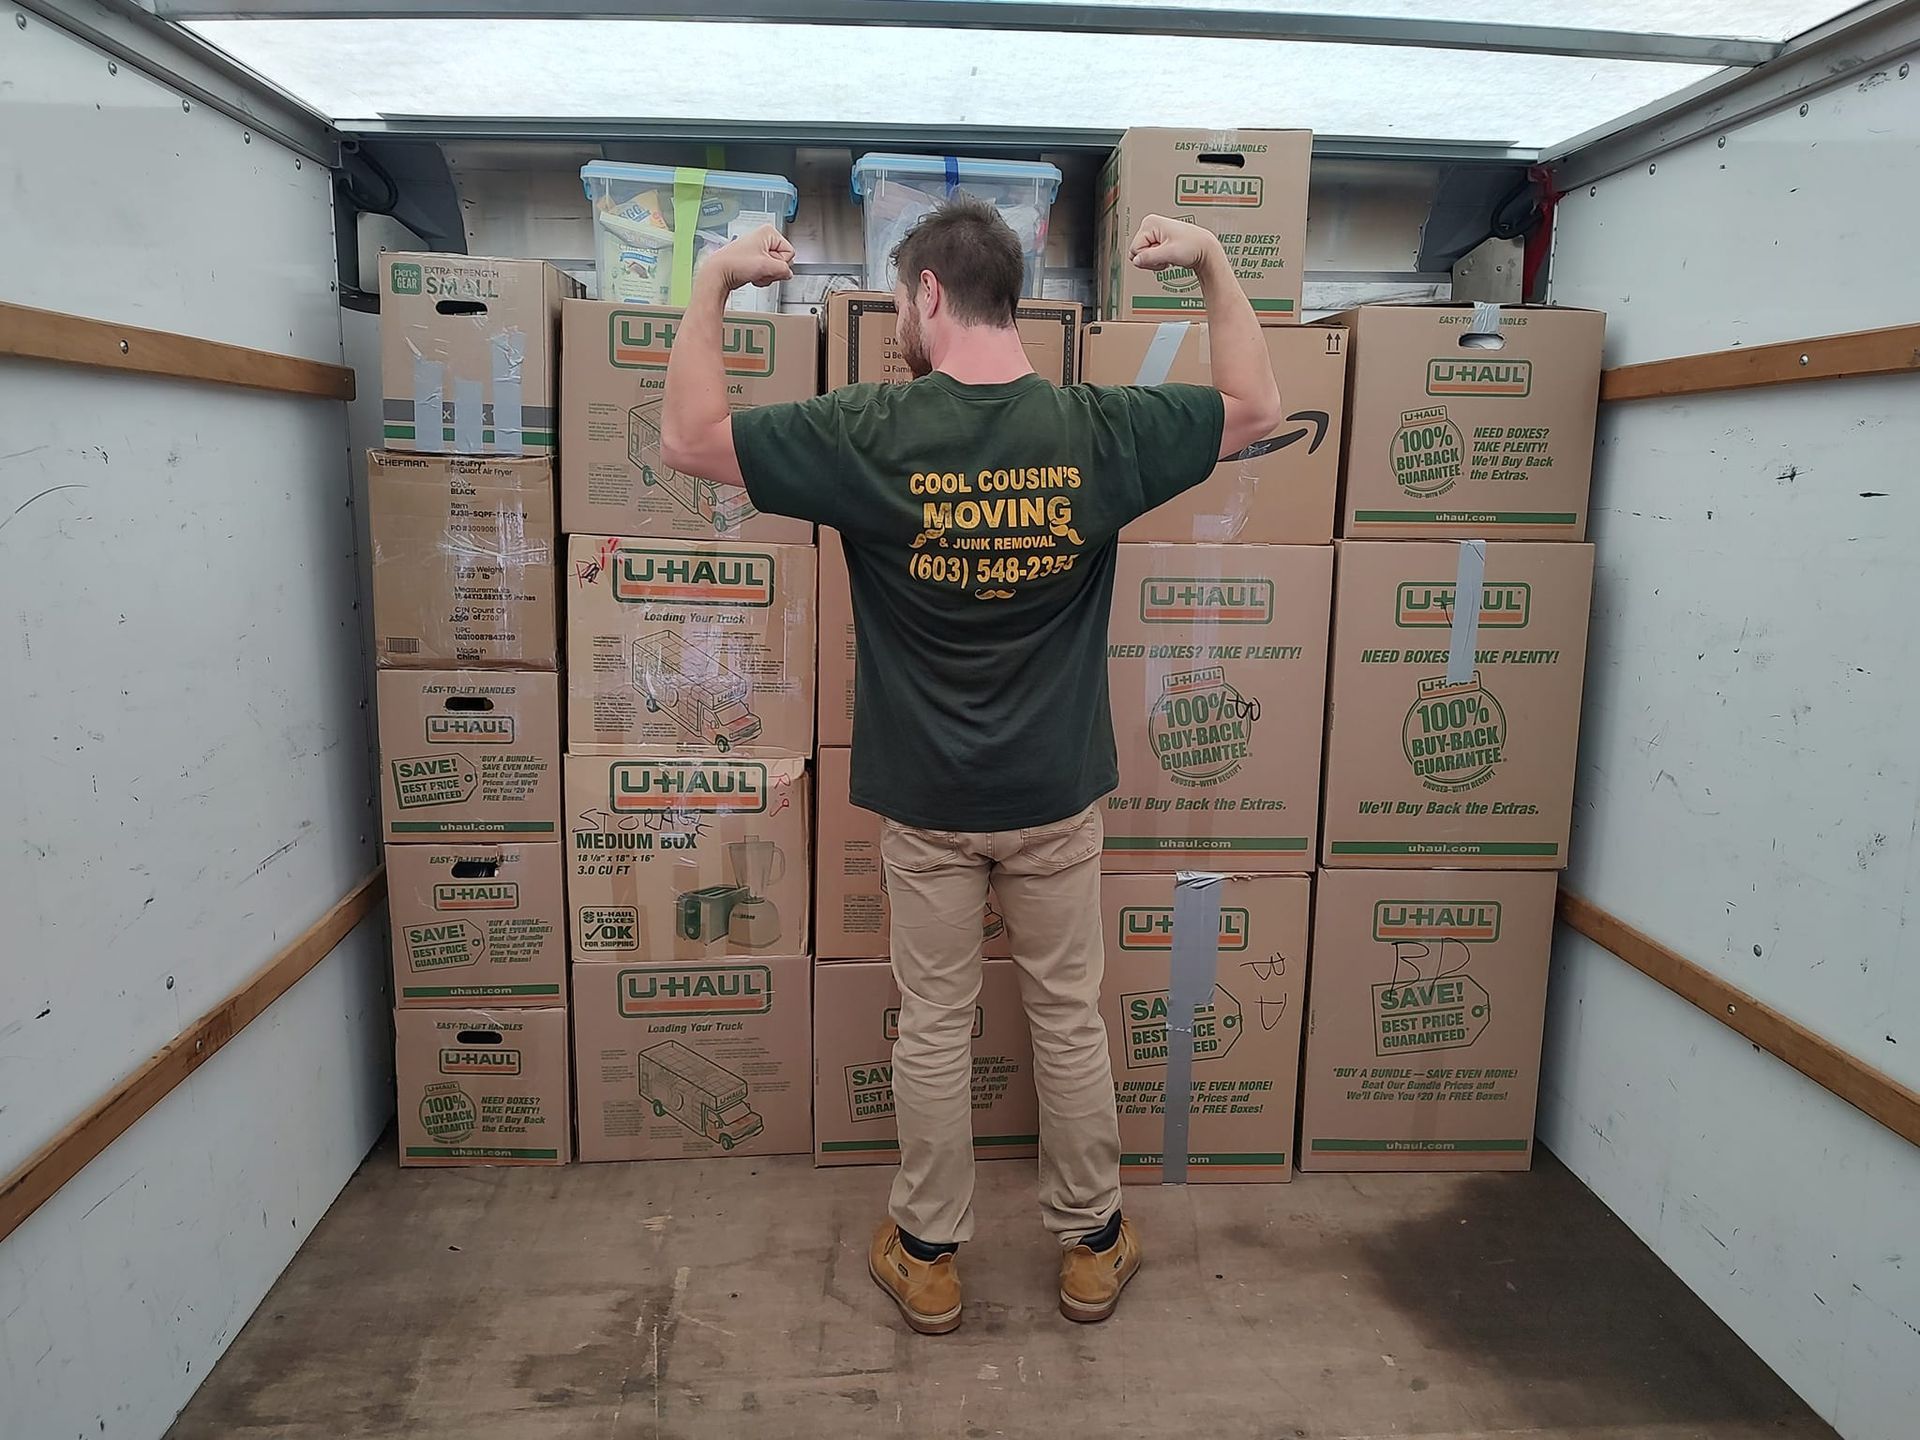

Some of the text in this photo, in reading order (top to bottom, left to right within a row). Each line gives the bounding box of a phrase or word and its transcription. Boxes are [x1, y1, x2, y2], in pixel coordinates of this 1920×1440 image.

[1182, 180, 1257, 195] U-HAUL
[1245, 235, 1280, 244] BOXES?
[1242, 246, 1279, 256] PLENTY!
[1241, 258, 1285, 268] Buy Back
[397, 278, 417, 289] GEAR
[1434, 365, 1525, 383] U-HAUL
[1400, 424, 1453, 453] 100%
[1473, 427, 1549, 439] NEED BOXES?
[1473, 442, 1548, 453] TAKE PLENTY!
[1397, 448, 1460, 471] BUY-BACK
[1471, 455, 1554, 469] We'll Buy Back
[495, 468, 512, 476] Fryer
[1398, 464, 1461, 486] GUARANTEE
[1470, 470, 1529, 481] the Extras.
[909, 466, 1082, 495] COOL COUSIN'S
[923, 495, 1072, 529] MOVING
[1435, 512, 1497, 522] uhaul.com
[939, 535, 1056, 550] & JUNK REMOVAL
[624, 558, 764, 586] U-HAUL
[909, 552, 969, 589] (603)
[1151, 586, 1265, 607] U-HAUL
[644, 612, 746, 624] Loading Your Truck
[1108, 645, 1302, 659] NEED BOXES? TAKE PLENTY!
[1361, 650, 1560, 664] NEED PLENTY!
[1416, 695, 1490, 733] 100%
[431, 720, 509, 733] U-HAUL
[1158, 721, 1246, 752] BUY-BACK
[1411, 726, 1500, 757] BUY-BACK
[1160, 741, 1248, 771] GUARANTEE
[1413, 747, 1502, 777] GUARANTEE
[399, 758, 458, 778] SAVE!
[402, 780, 460, 794] BEST PRICE
[621, 770, 756, 793] U-HAUL
[1107, 797, 1287, 812] We'll Buy Back the Extras.
[1358, 801, 1540, 817] We'll Buy Back the Extras.
[440, 823, 505, 831] uhaul.com
[576, 833, 653, 849] MEDIUM
[1159, 839, 1231, 849] uhaul.com
[1408, 844, 1480, 853] uhaul.com
[577, 854, 588, 862] 18
[615, 854, 630, 862] 18"
[641, 854, 655, 862] 16"
[577, 865, 630, 875] 3.0 CU FT
[439, 887, 513, 900] U-HAUL
[1382, 907, 1492, 926] U-HAUL
[409, 924, 466, 943] SAVE!
[601, 925, 633, 939] OK
[413, 944, 467, 958] BEST PRICE
[628, 974, 761, 999] U-HAUL
[1380, 982, 1464, 1010] SAVE!
[647, 1021, 744, 1034] Loading Your Truck
[1382, 1012, 1464, 1034] BEST PRICE
[445, 1053, 516, 1065] U-HAUL
[1360, 1068, 1518, 1078] A BUNDLE SAVE EVEN MORE!
[1123, 1081, 1273, 1090] BUNDLE EVEN MORE!
[1361, 1080, 1495, 1090] Beat Our Bundle Prices and
[481, 1096, 541, 1105] NEED BOXES?
[854, 1094, 882, 1104] BEST
[1139, 1094, 1250, 1102] Our Prices and
[1346, 1091, 1508, 1101] We'll Give You FREE Boxes!
[425, 1095, 467, 1114] 100%
[482, 1106, 539, 1115] TAKE PLENTY!
[1126, 1104, 1263, 1113] Give FREE Boxes!
[425, 1109, 473, 1126] BUY-BACK
[505, 1116, 545, 1125] Buy Back
[427, 1122, 475, 1136] GUARANTEE
[482, 1125, 496, 1133] the
[451, 1149, 512, 1157] uhaul.com
[1386, 1142, 1455, 1150] uhaul.com
